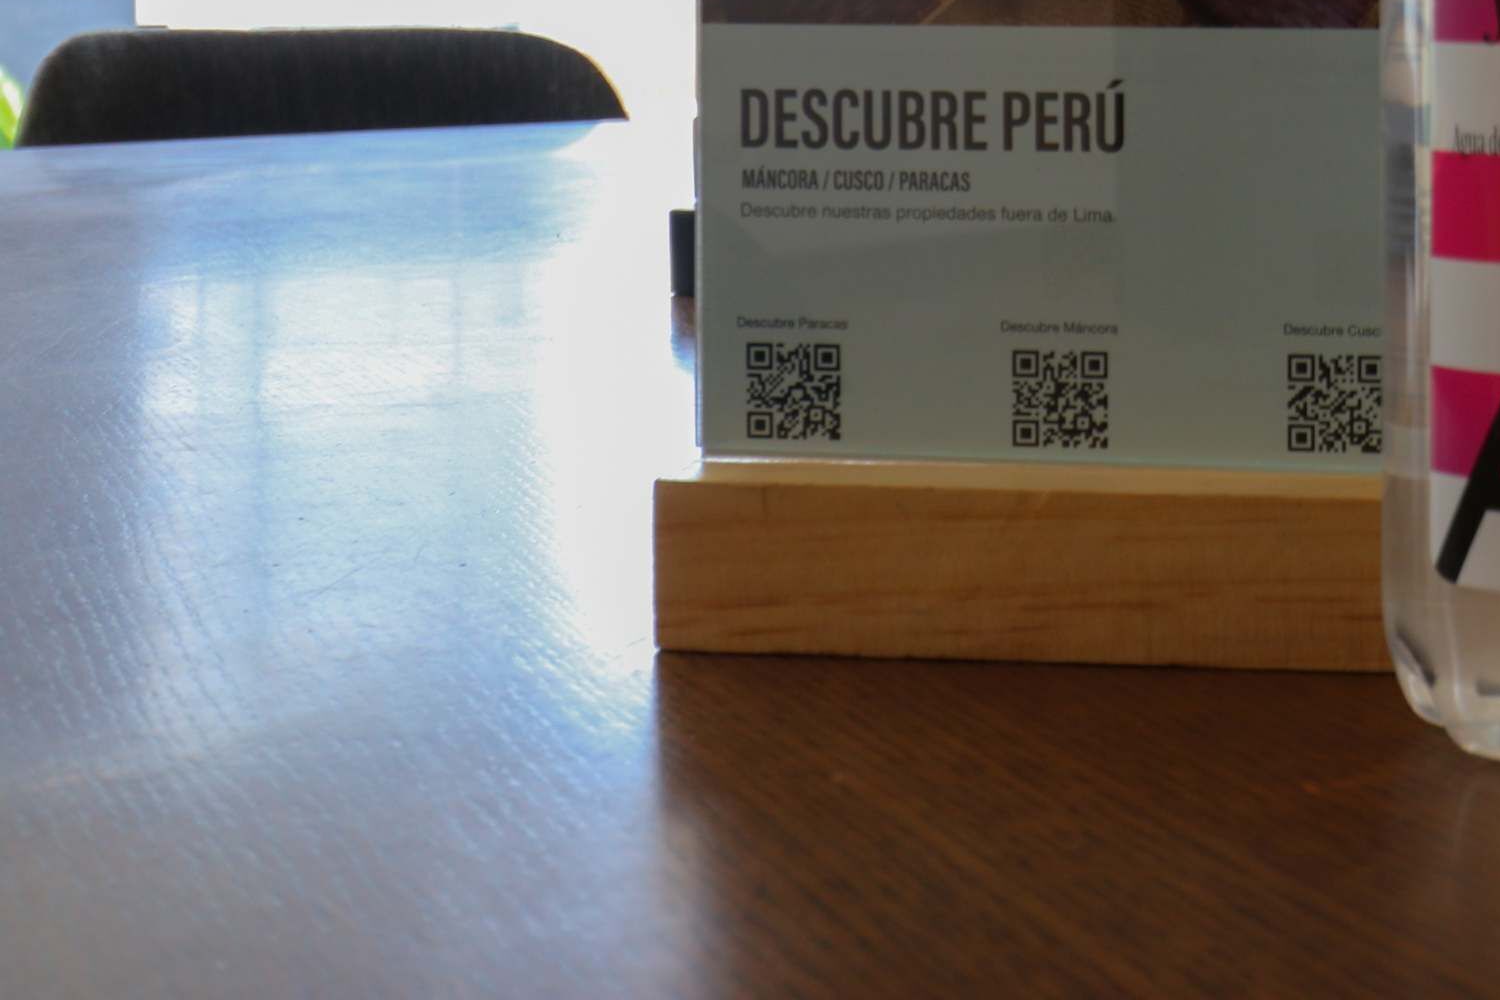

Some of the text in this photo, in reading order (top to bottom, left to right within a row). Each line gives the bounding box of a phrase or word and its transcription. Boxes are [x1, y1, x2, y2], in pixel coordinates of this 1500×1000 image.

[740, 78, 1125, 153] DESCUBRE PERÚ
[741, 165, 818, 190] MÁNCORA
[833, 169, 884, 191] CUSCO
[899, 170, 971, 192] PARACAS
[740, 201, 1116, 223] Descubre nuestras propiedades fuera de Lima.
[736, 315, 848, 330] Descubre Paracas
[1000, 319, 1118, 335] Descubre Máncora
[1282, 322, 1382, 338] Descubre Cusc
